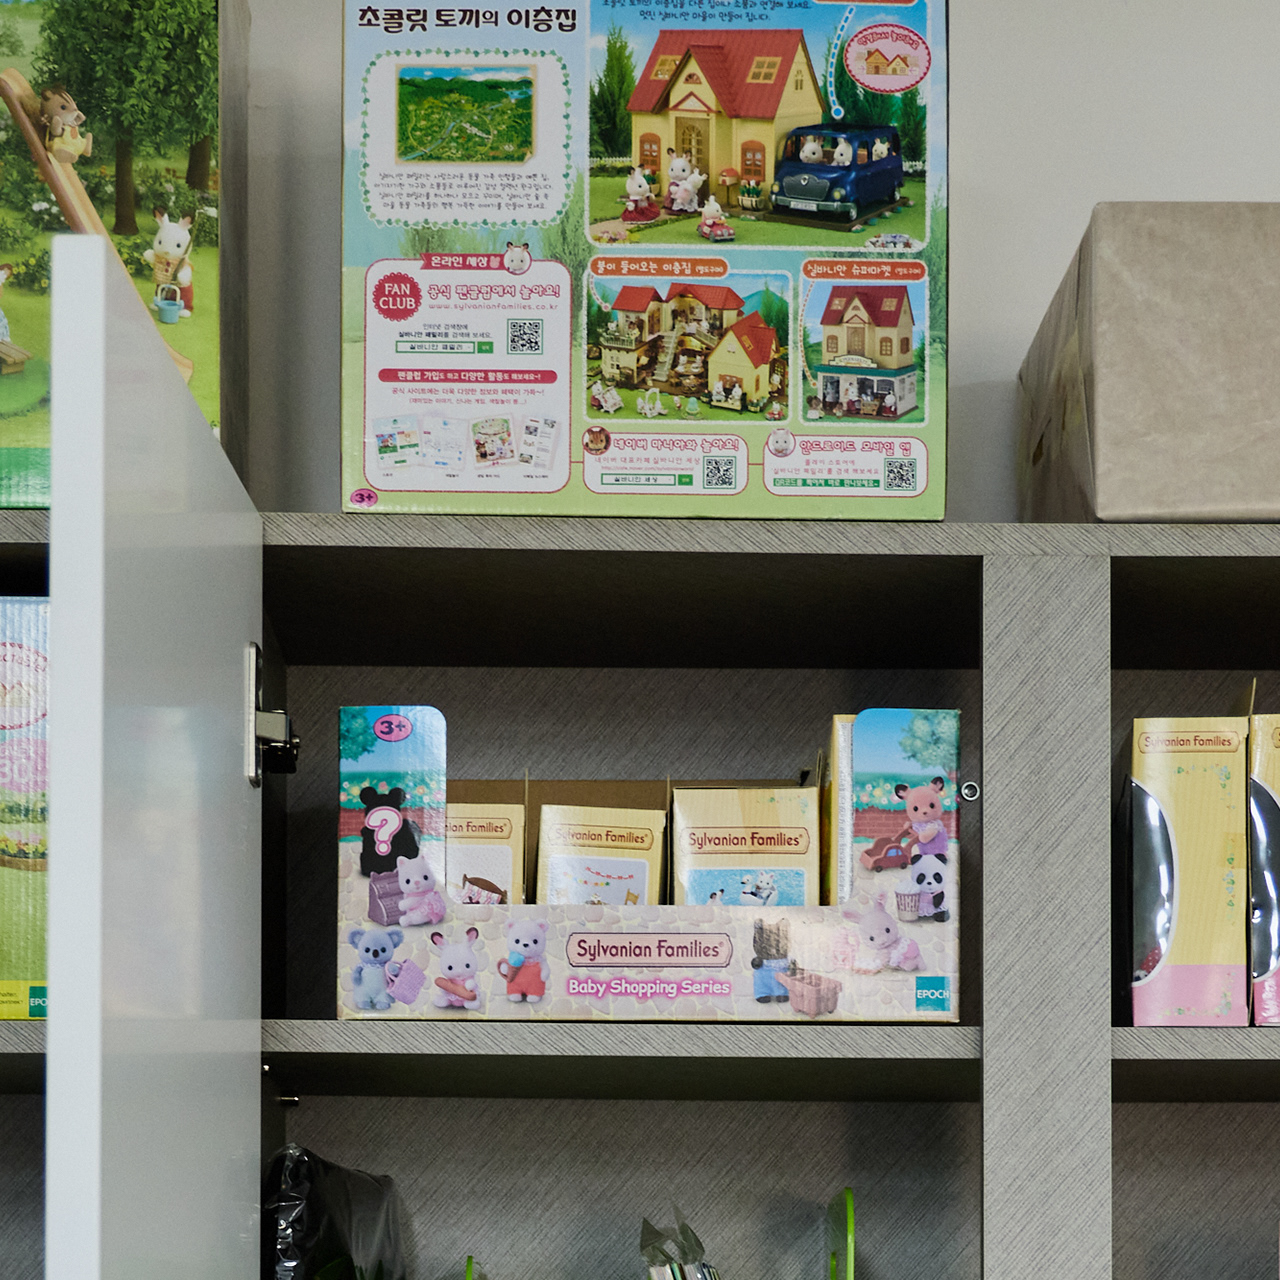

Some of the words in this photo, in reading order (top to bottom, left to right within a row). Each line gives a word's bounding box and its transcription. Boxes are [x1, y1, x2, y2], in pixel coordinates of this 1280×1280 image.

[358, 6, 427, 33] 초콜릿
[435, 8, 498, 28] 토끼의
[507, 6, 577, 33] 이층집
[431, 256, 463, 268] 온라인
[466, 256, 488, 268] 세상
[620, 261, 657, 272] 들어오는
[662, 263, 692, 274] 이층집
[808, 263, 847, 276] 실바니안
[851, 264, 892, 277] 슈퍼마켓
[384, 283, 411, 295] FAN
[427, 284, 451, 299] 공식
[455, 284, 516, 300] 팬클럽에서
[520, 284, 560, 300] 놀아요!
[379, 297, 416, 310] CLUB
[461, 371, 484, 381] 다양한
[613, 438, 648, 451] 네이버
[651, 438, 698, 451] 마니아와
[700, 438, 739, 453] 놀아요!
[799, 440, 856, 455] 안드로이드
[861, 441, 895, 456] 모바일
[353, 493, 374, 504] 3+
[379, 720, 406, 735] 3+
[689, 832, 746, 850] Sylvanian
[577, 939, 652, 962] Sylvanian
[569, 979, 606, 997] Baby
[610, 979, 677, 997] Shopping
[681, 980, 730, 994] Series
[917, 989, 950, 999] EPOCH
